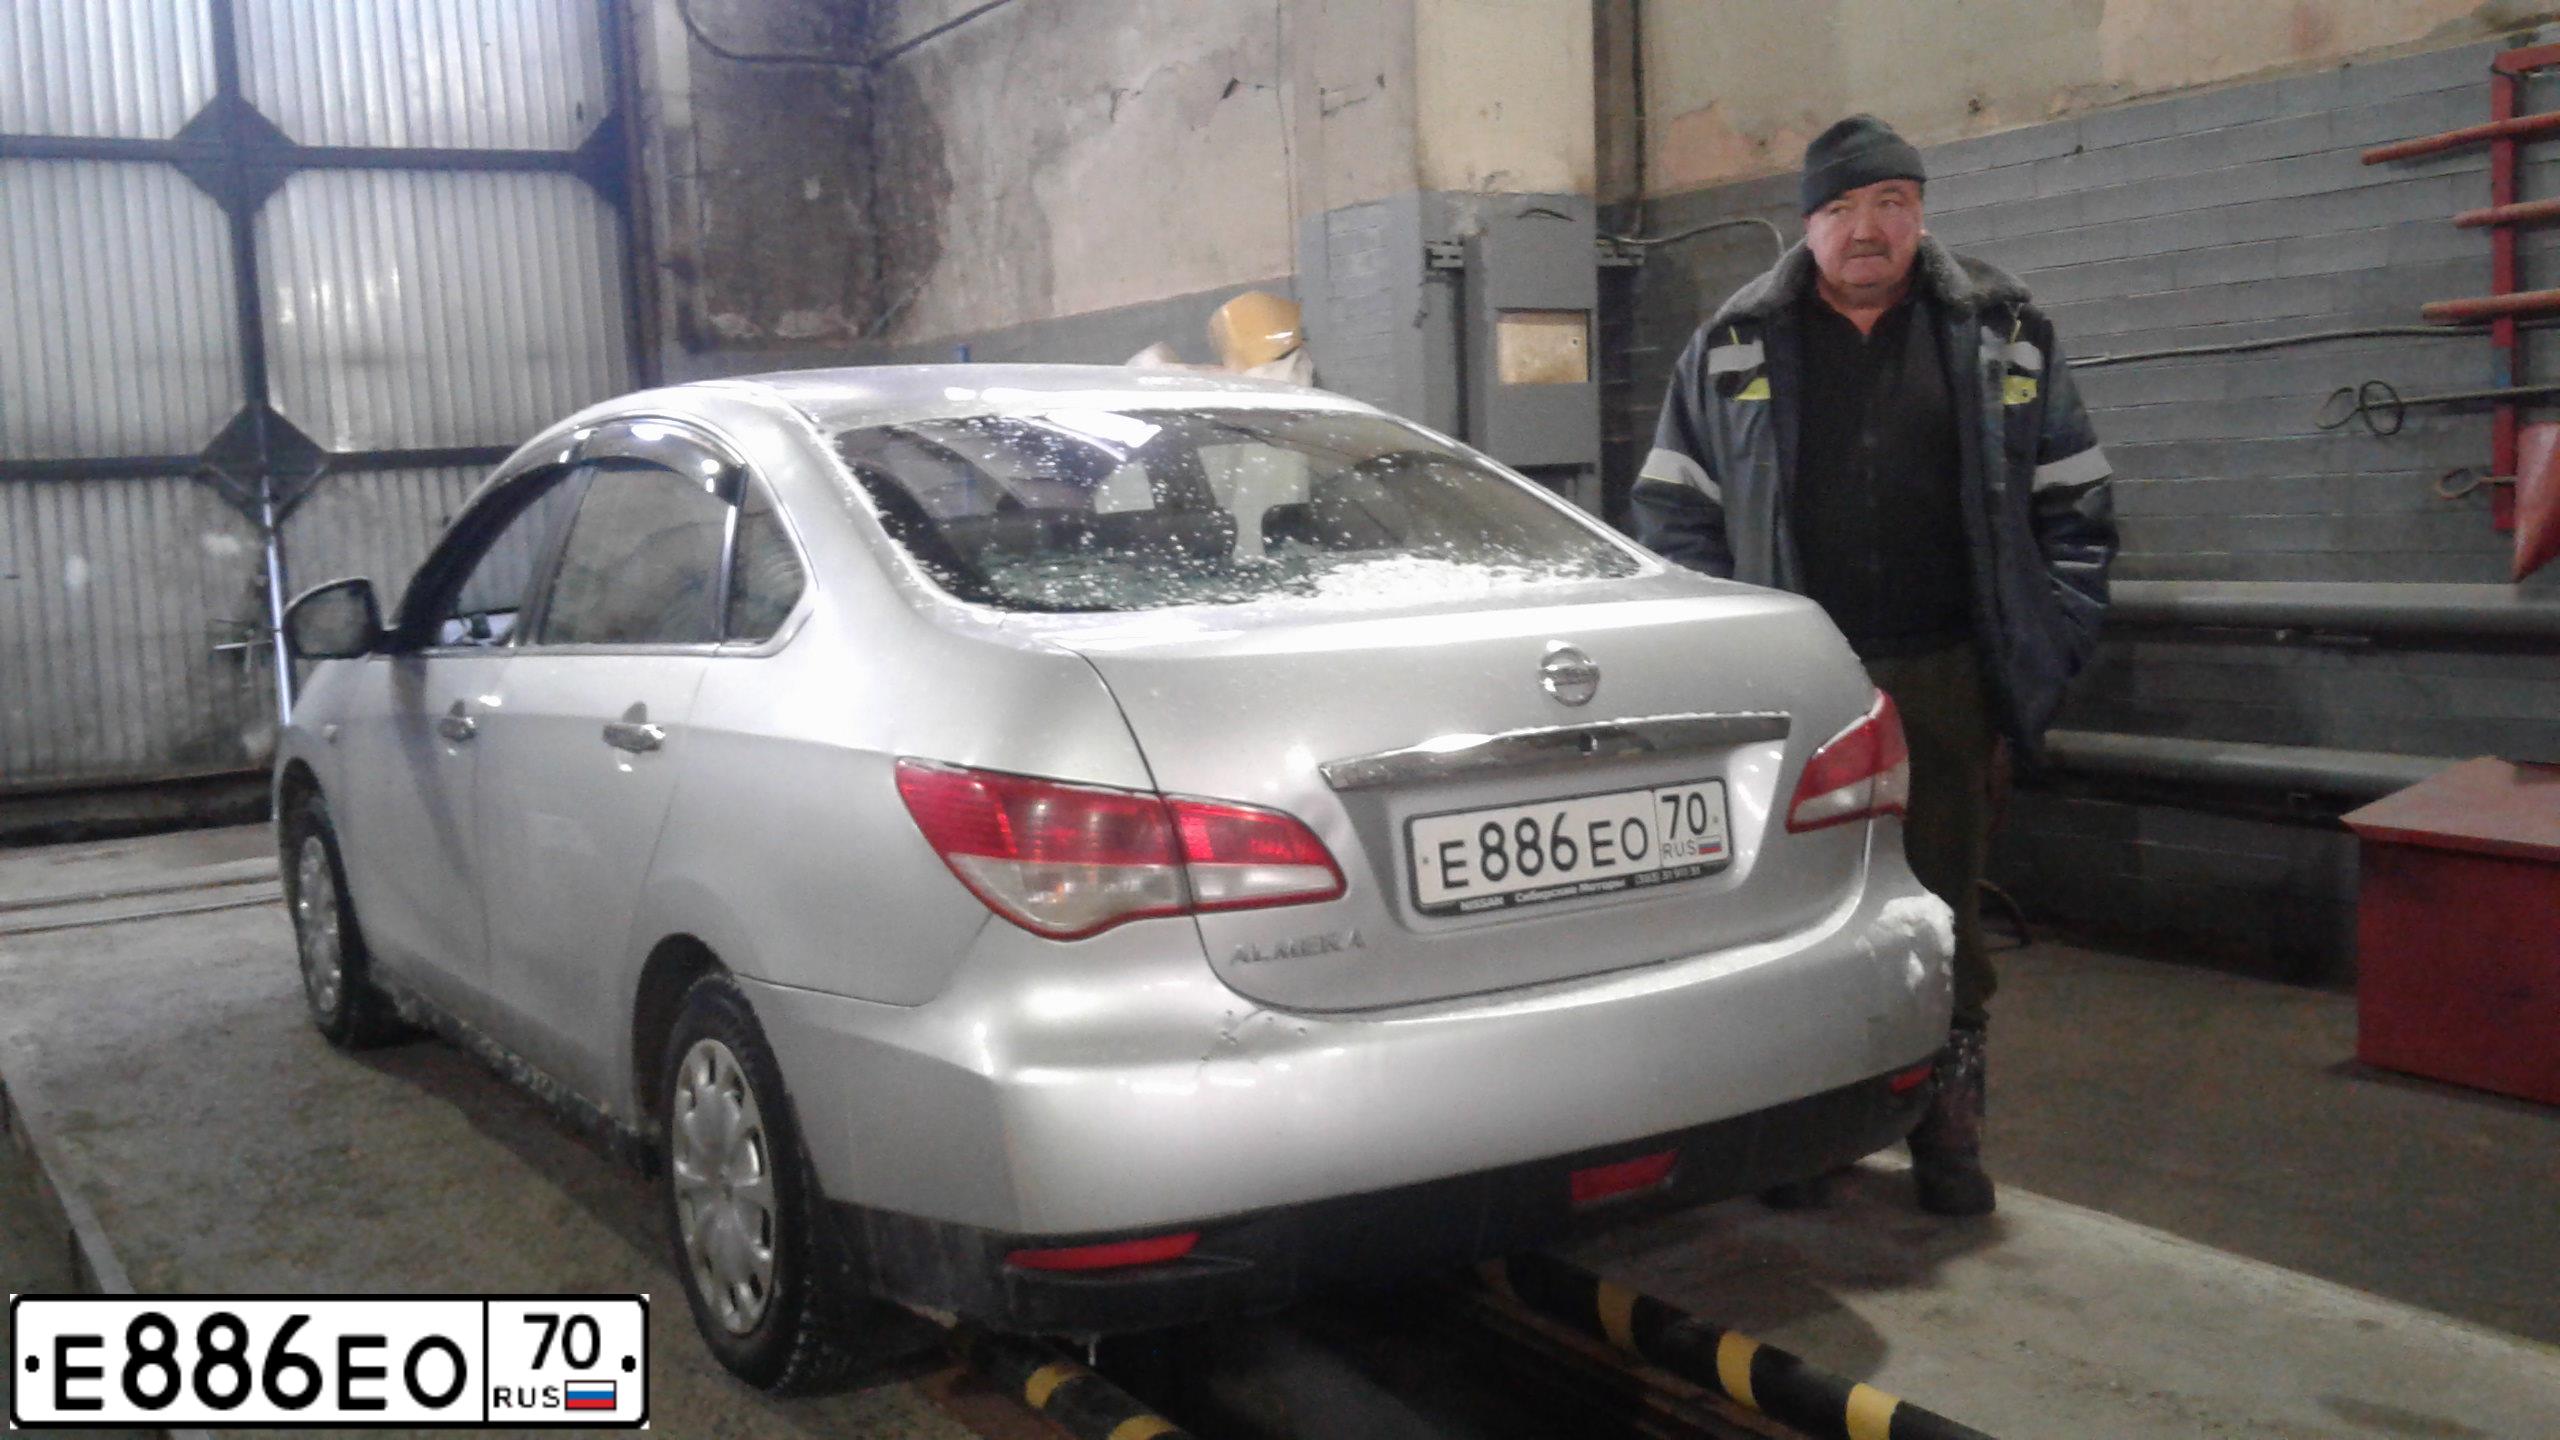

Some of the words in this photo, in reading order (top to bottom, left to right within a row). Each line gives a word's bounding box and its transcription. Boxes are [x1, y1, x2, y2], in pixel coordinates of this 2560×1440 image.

[1438, 812, 1650, 890] E886EO
[1660, 791, 1708, 840] 70
[1662, 838, 1698, 860] RUS
